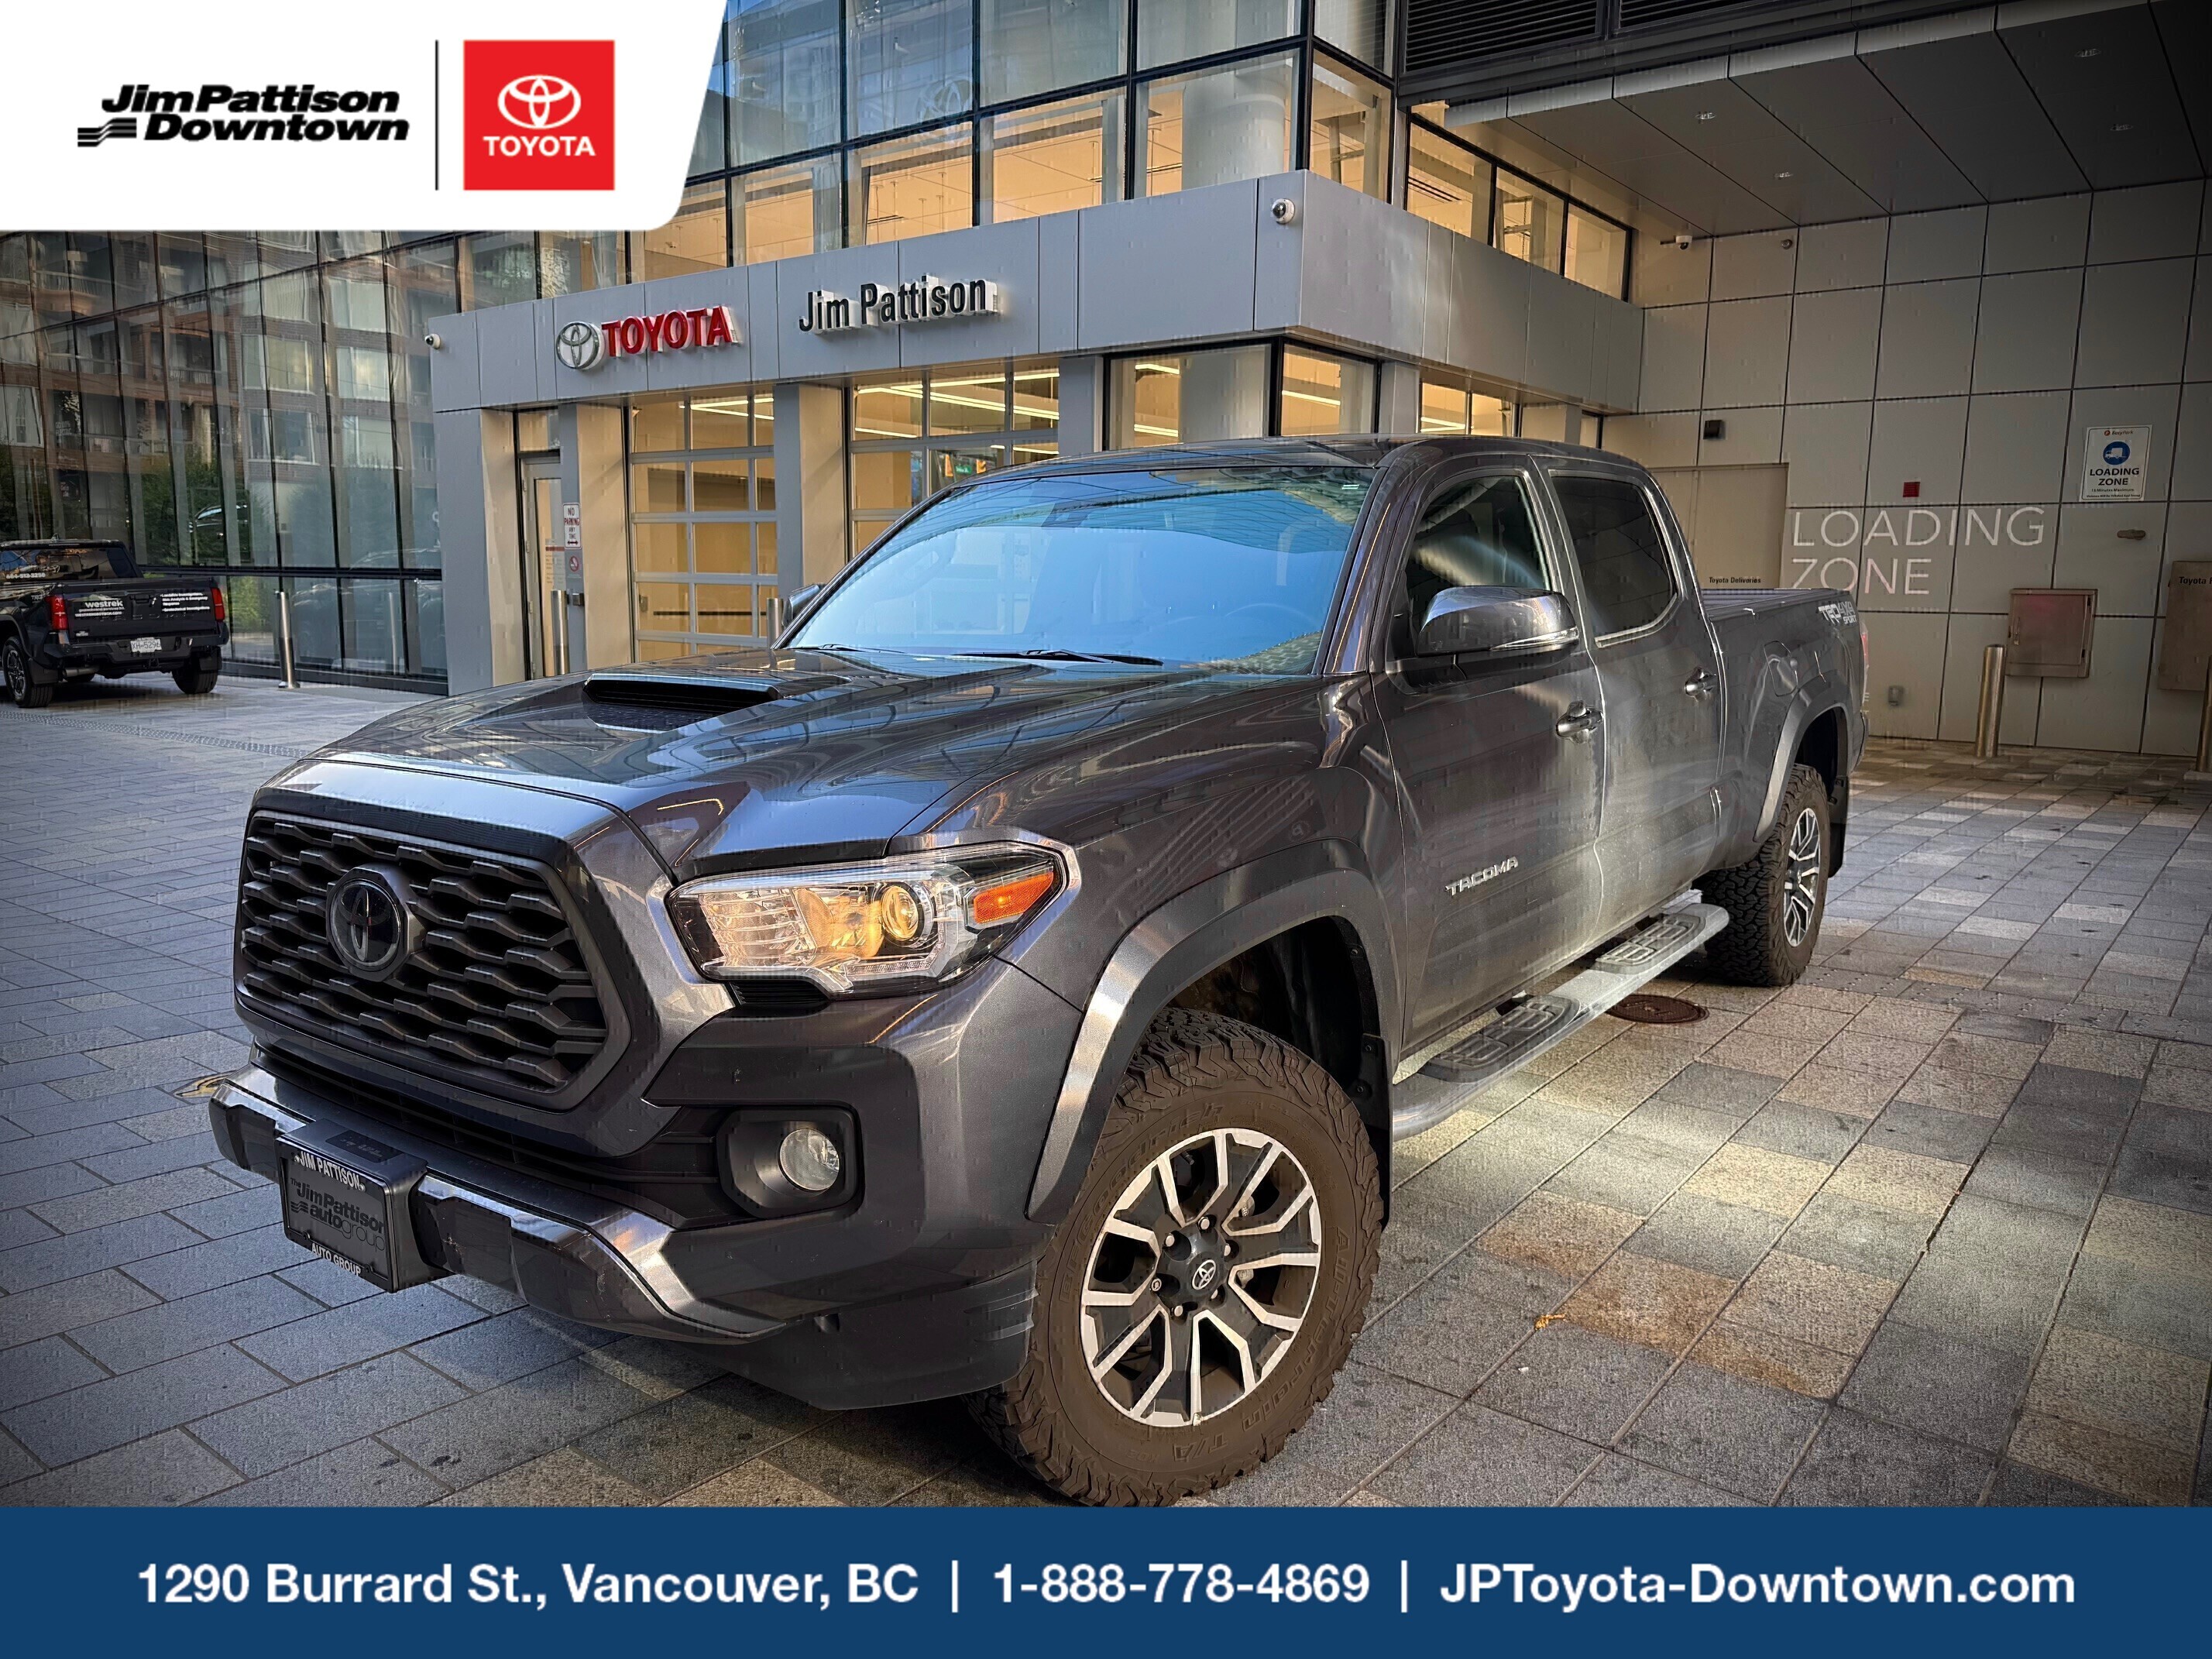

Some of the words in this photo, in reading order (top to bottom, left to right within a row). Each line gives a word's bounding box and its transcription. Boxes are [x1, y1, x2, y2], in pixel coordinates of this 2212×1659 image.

[799, 289, 855, 333] Jim
[860, 275, 993, 325] Pattison
[601, 305, 738, 358] TOYOTA
[2090, 467, 2140, 476] LOADING
[568, 507, 575, 517] NO
[564, 517, 580, 526] PARKING
[1792, 507, 2045, 548] LOADING
[1709, 576, 1729, 585] Toyota
[1791, 557, 1932, 595] ZONE
[2179, 576, 2207, 586] Toyota
[85, 599, 124, 608] westrek
[1818, 603, 1841, 625] TRD
[1843, 614, 1857, 625] SPORT
[1444, 856, 1519, 896] TACOMA
[300, 1150, 317, 1172] JIM
[318, 1158, 361, 1190] PATTISON
[290, 1177, 301, 1188] The
[311, 1242, 332, 1261] AUTO
[333, 1253, 362, 1277] GROUP
